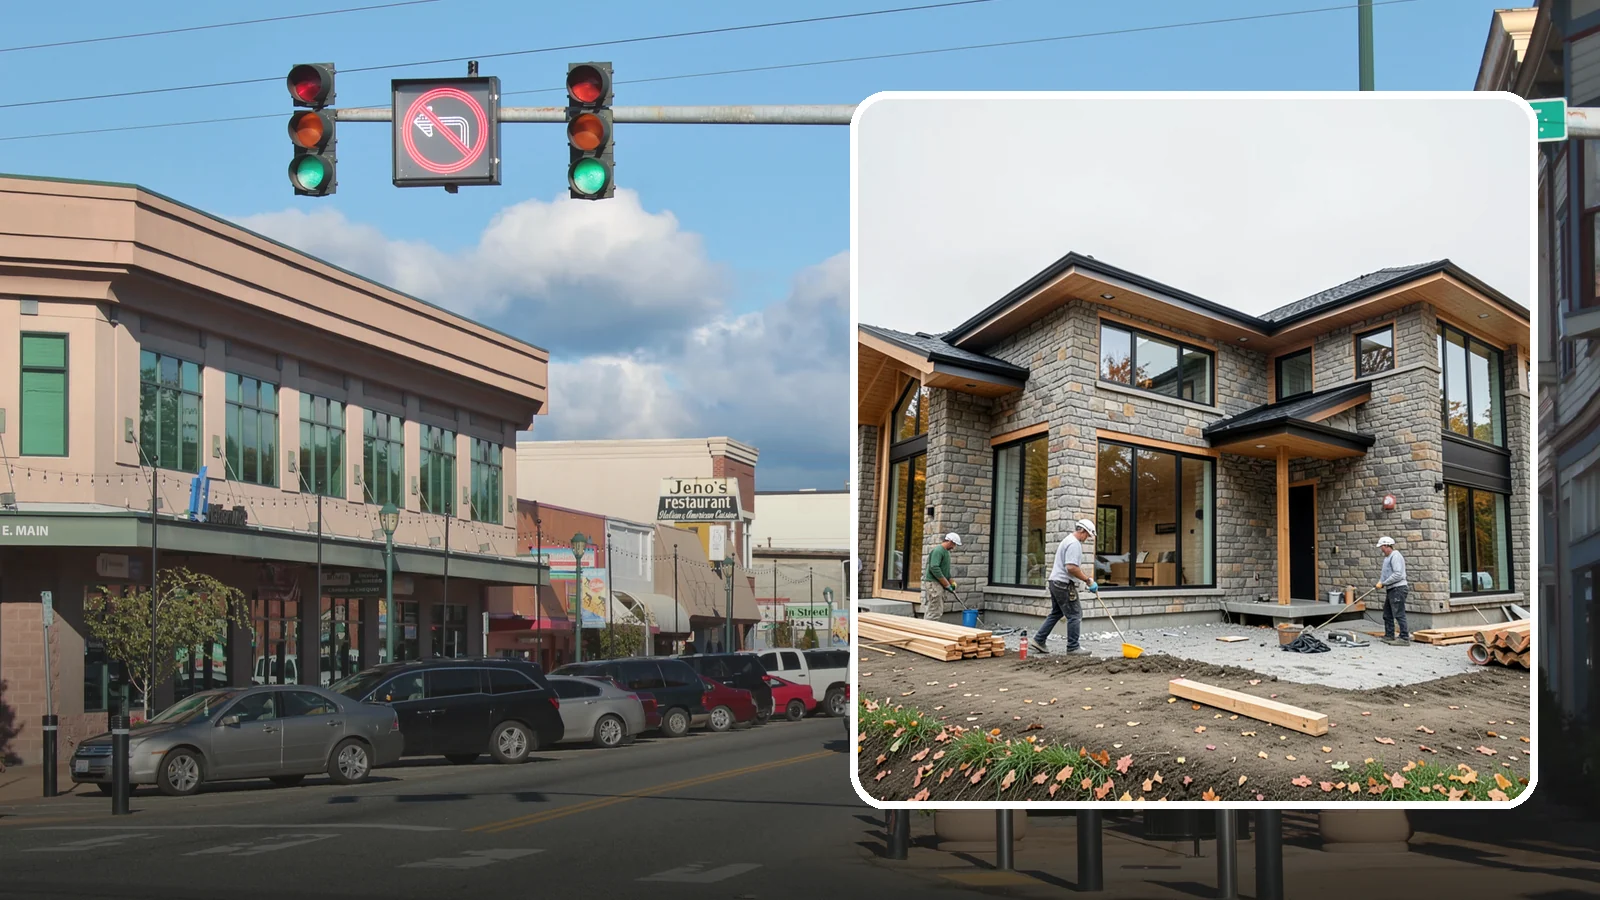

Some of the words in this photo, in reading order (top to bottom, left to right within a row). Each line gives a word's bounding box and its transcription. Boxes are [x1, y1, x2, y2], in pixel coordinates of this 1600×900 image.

[670, 480, 727, 494] Jeno's
[665, 496, 731, 509] restaurant
[686, 509, 714, 519] American
[715, 509, 737, 519] Cuisine
[2, 525, 13, 536] E.
[15, 525, 49, 536] MAIN
[797, 607, 828, 617] Street
